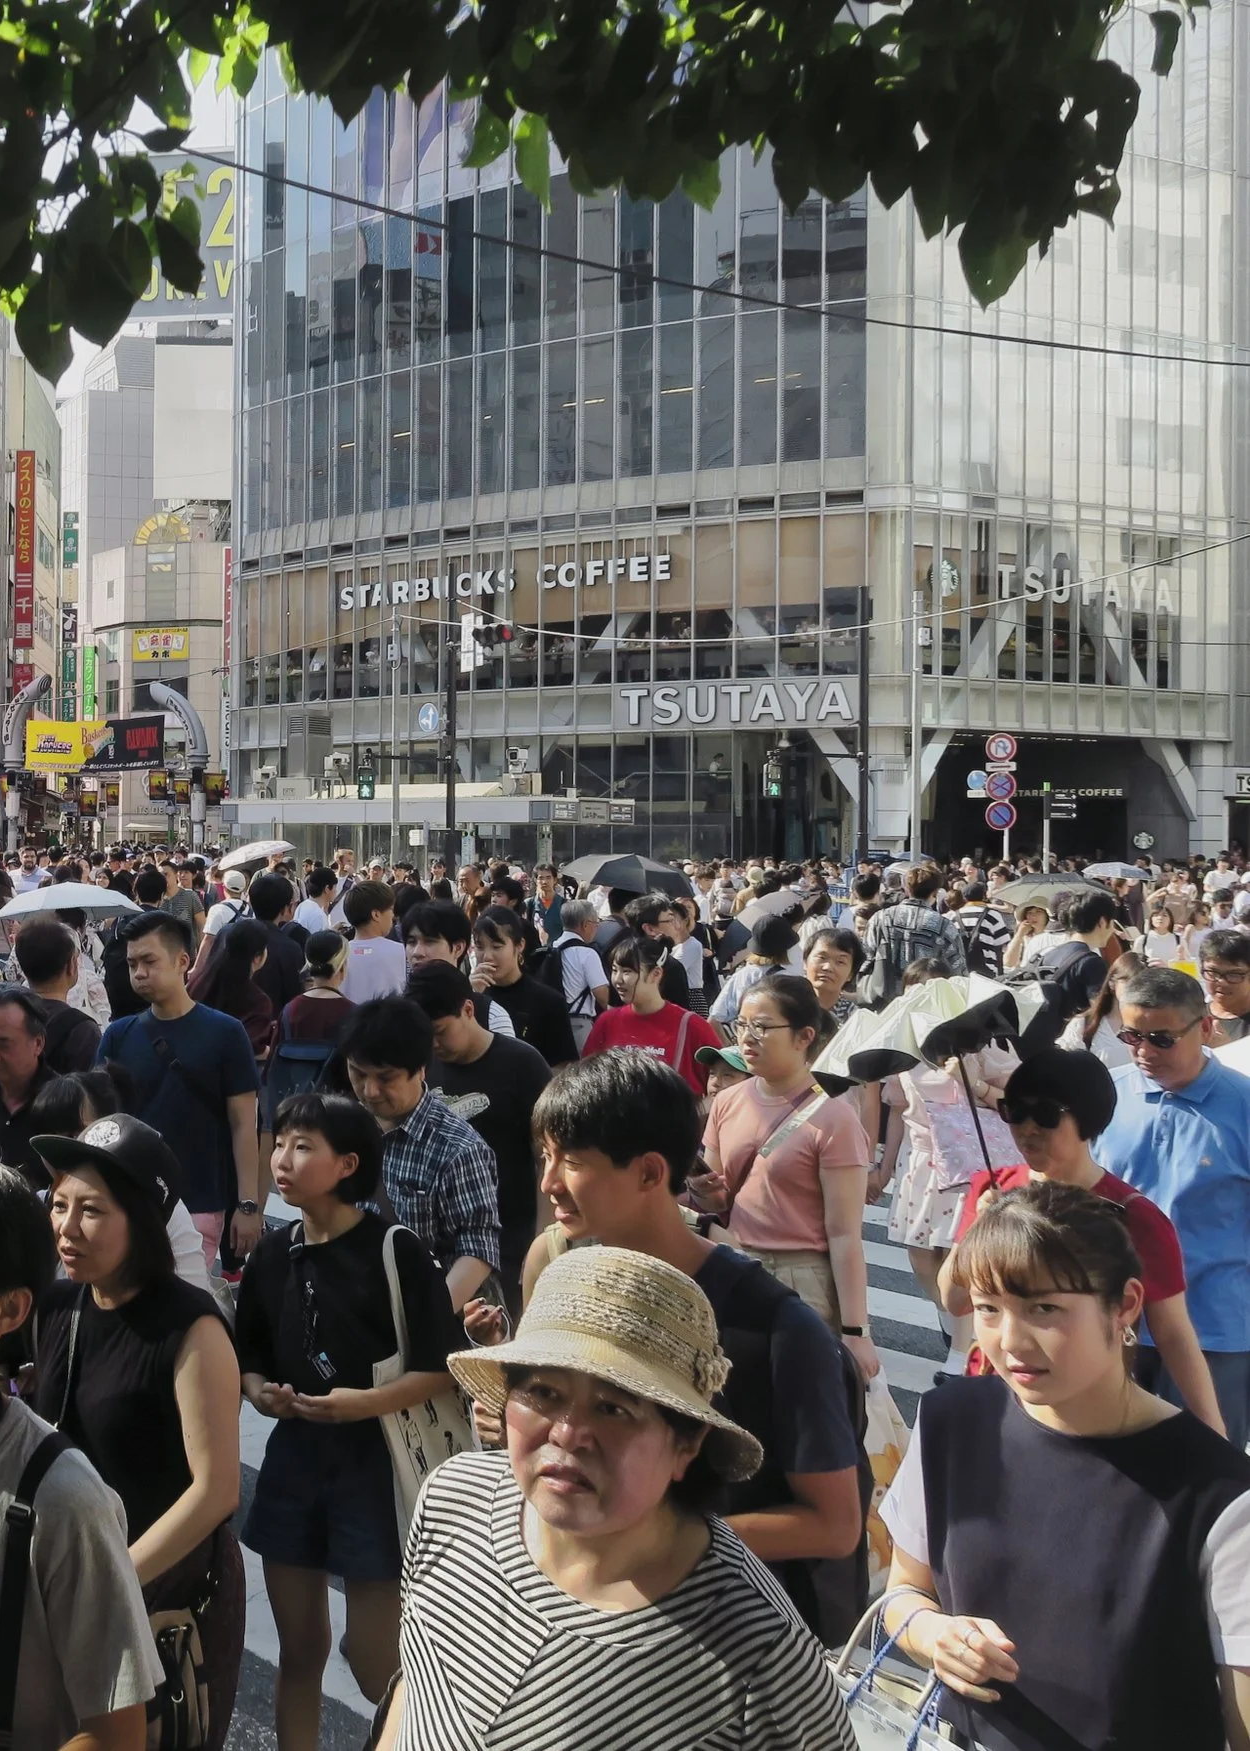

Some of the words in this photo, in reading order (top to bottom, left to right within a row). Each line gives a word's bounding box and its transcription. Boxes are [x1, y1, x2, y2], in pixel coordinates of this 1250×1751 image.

[19, 455, 32, 564] クスリのことなら
[15, 572, 32, 639] 三千里
[340, 568, 516, 611] STARBUCKS
[536, 553, 671, 590] COFFEE
[997, 562, 1174, 613] TSUTAYA
[620, 682, 854, 726] TSUTAYA
[1078, 788, 1123, 797] COFFEE
